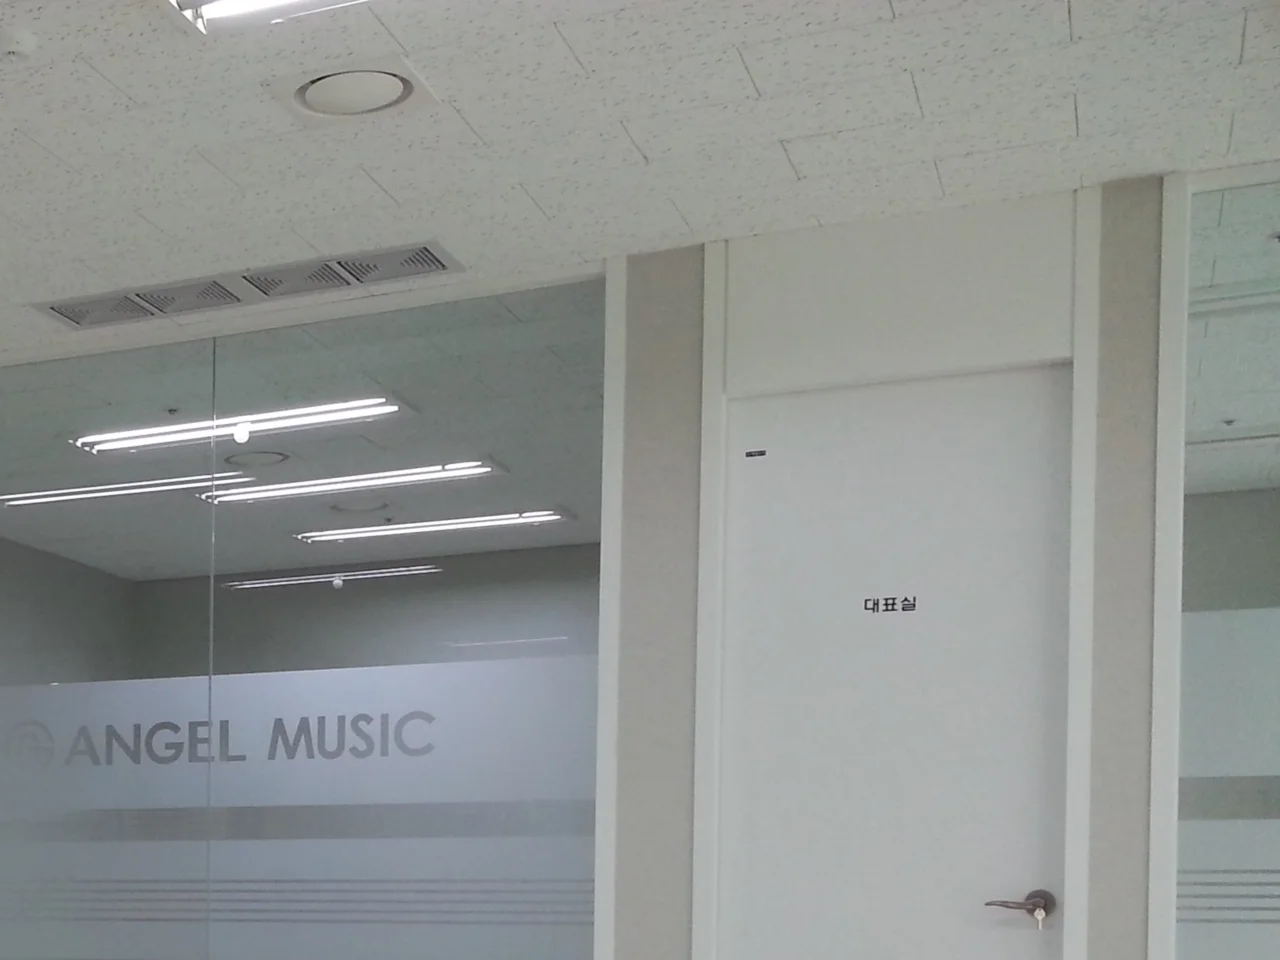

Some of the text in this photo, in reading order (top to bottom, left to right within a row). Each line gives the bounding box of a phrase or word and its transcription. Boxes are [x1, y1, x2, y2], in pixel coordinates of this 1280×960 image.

[863, 595, 917, 614] 대표실
[64, 710, 437, 766] ANGEL MUSIC
